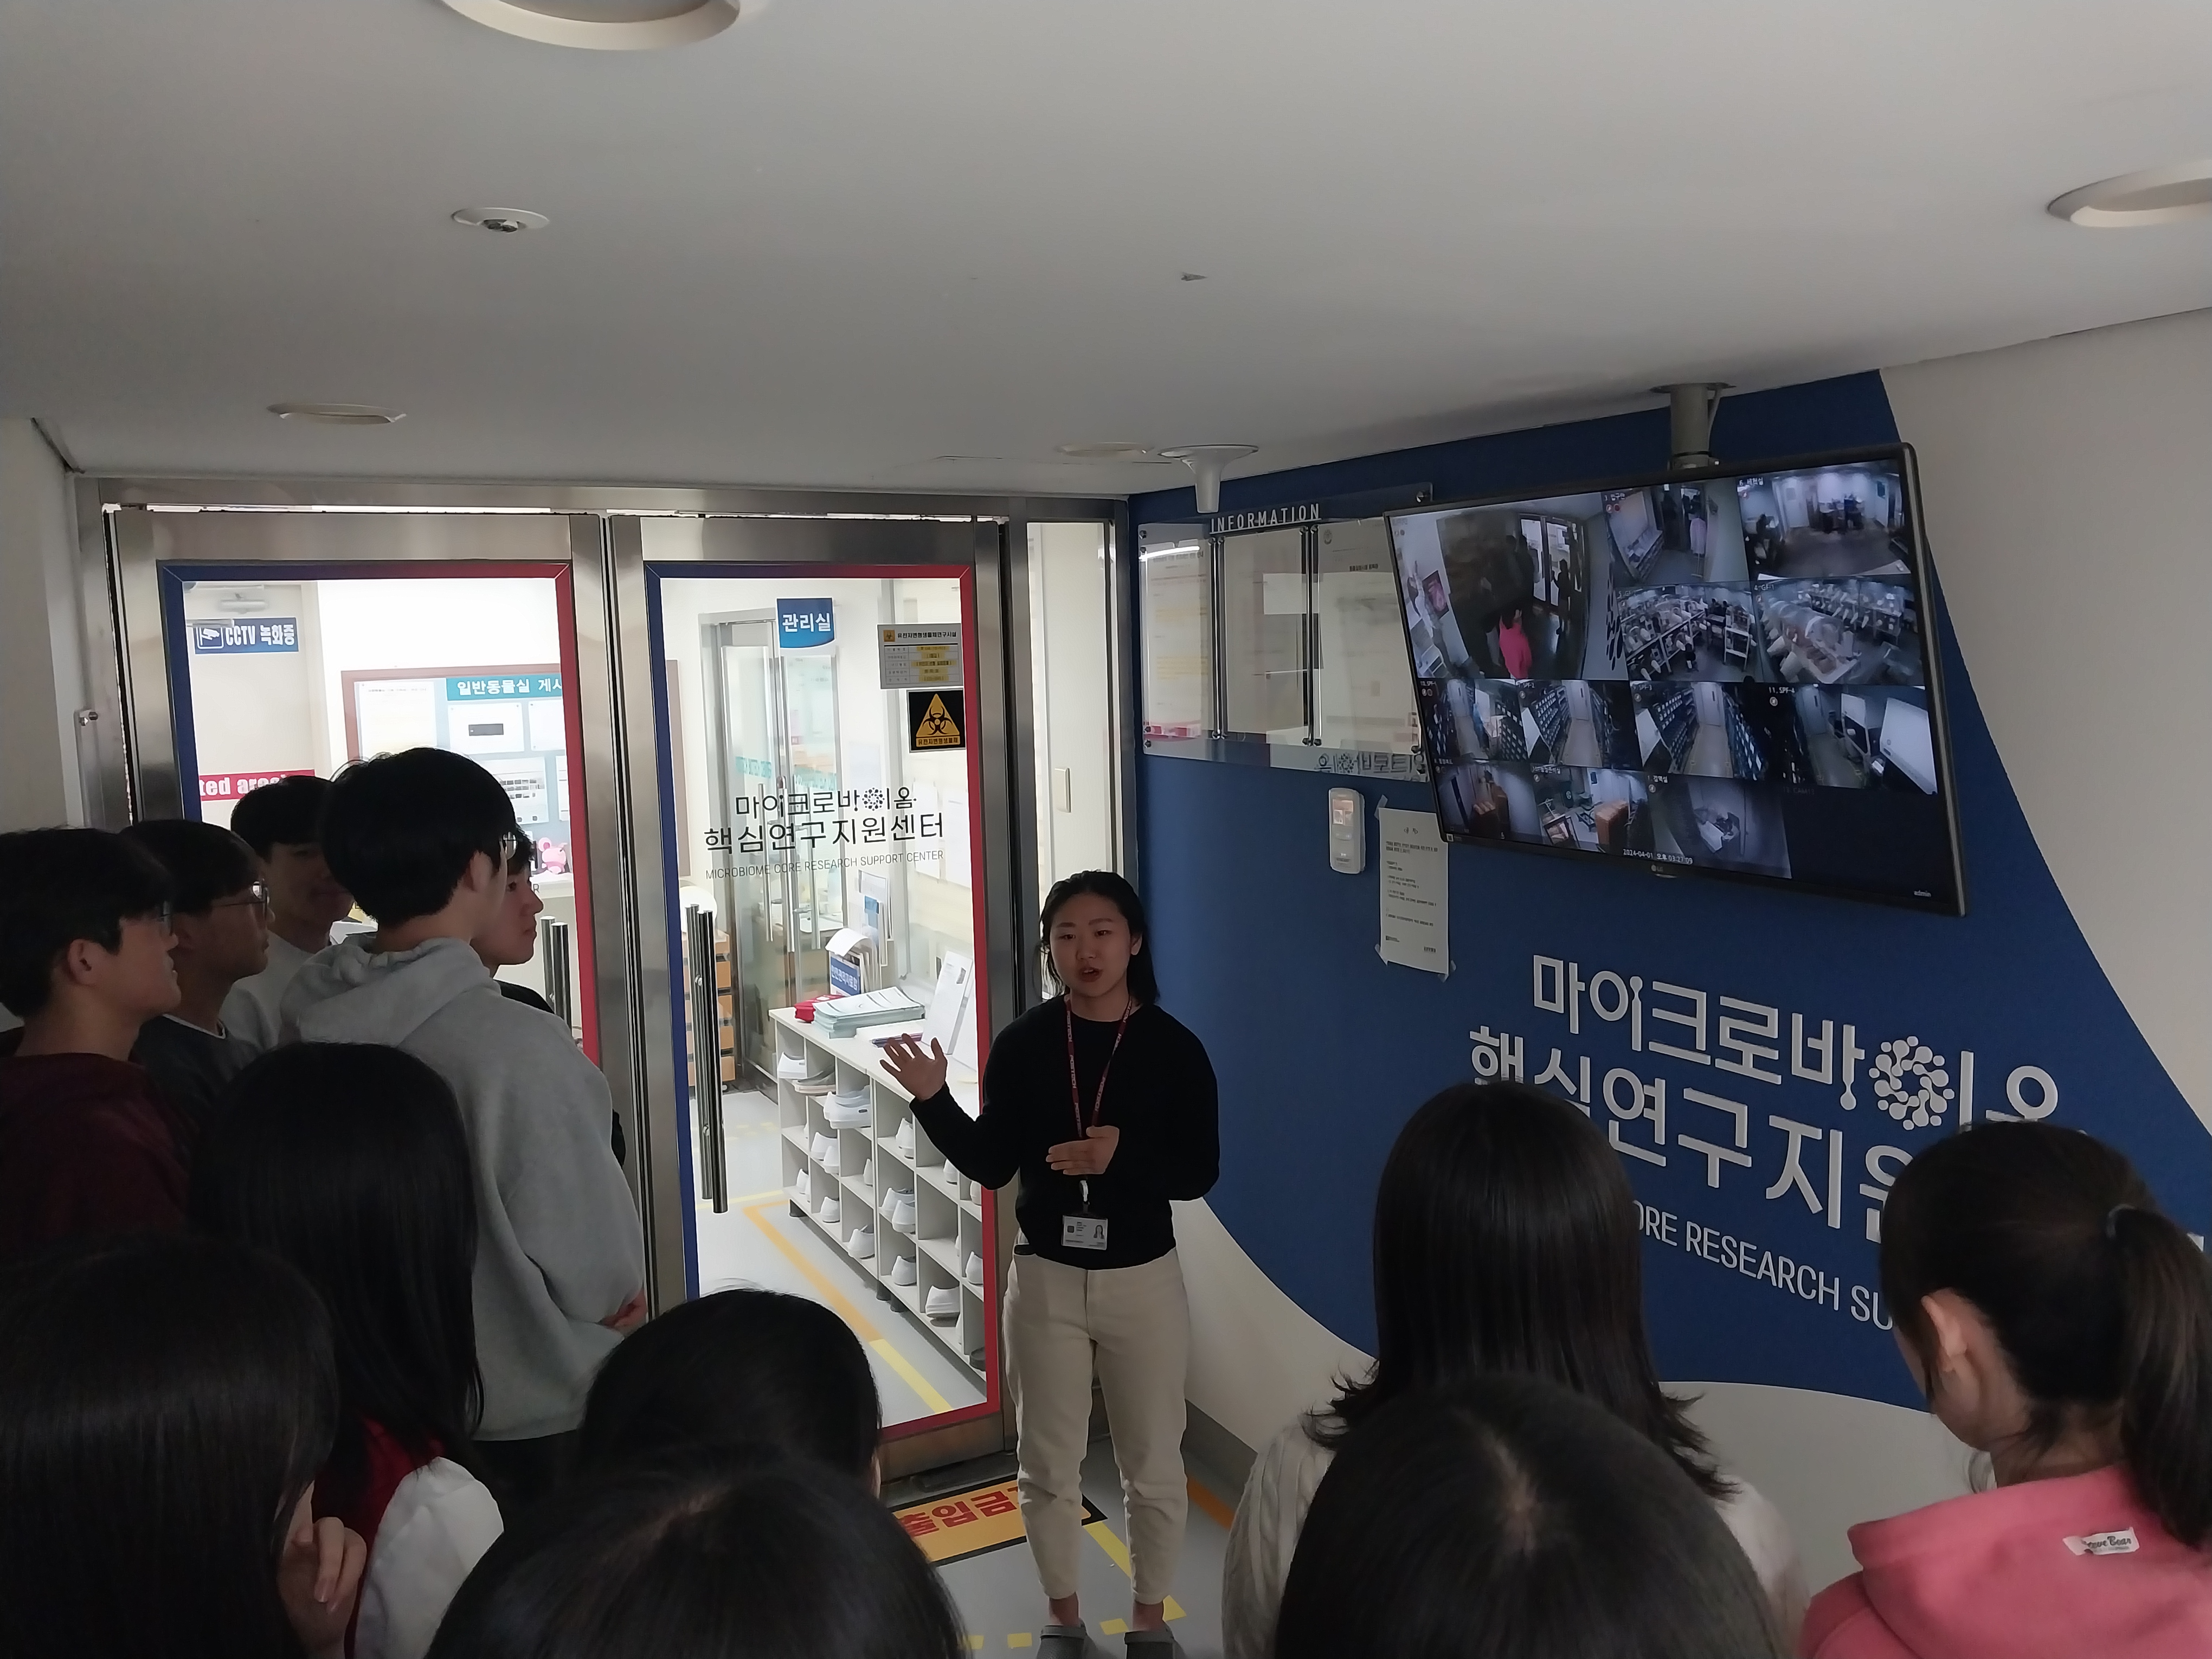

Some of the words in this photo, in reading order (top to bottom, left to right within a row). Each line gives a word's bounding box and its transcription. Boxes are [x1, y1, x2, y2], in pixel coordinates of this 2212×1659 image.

[1211, 503, 1319, 532] INFORMATION
[226, 625, 255, 646] CCTV
[260, 624, 295, 646] 녹화중
[782, 612, 831, 633] 관리실
[456, 678, 530, 696] 일반동물실
[918, 737, 958, 745] 유전자변형생물체
[735, 786, 917, 819] 마이크로바이옴
[704, 812, 943, 854] 핵심연구지원센터
[705, 864, 770, 880] MICROBIOME
[774, 861, 801, 874] CORE
[805, 857, 858, 871] RESEARCH
[860, 853, 904, 866] SUPPORT
[906, 850, 944, 863] CENTER
[1623, 848, 1653, 859] 2024-04-01
[1686, 1220, 1840, 1311] RESEARCH
[901, 1486, 1018, 1538] 출입금
